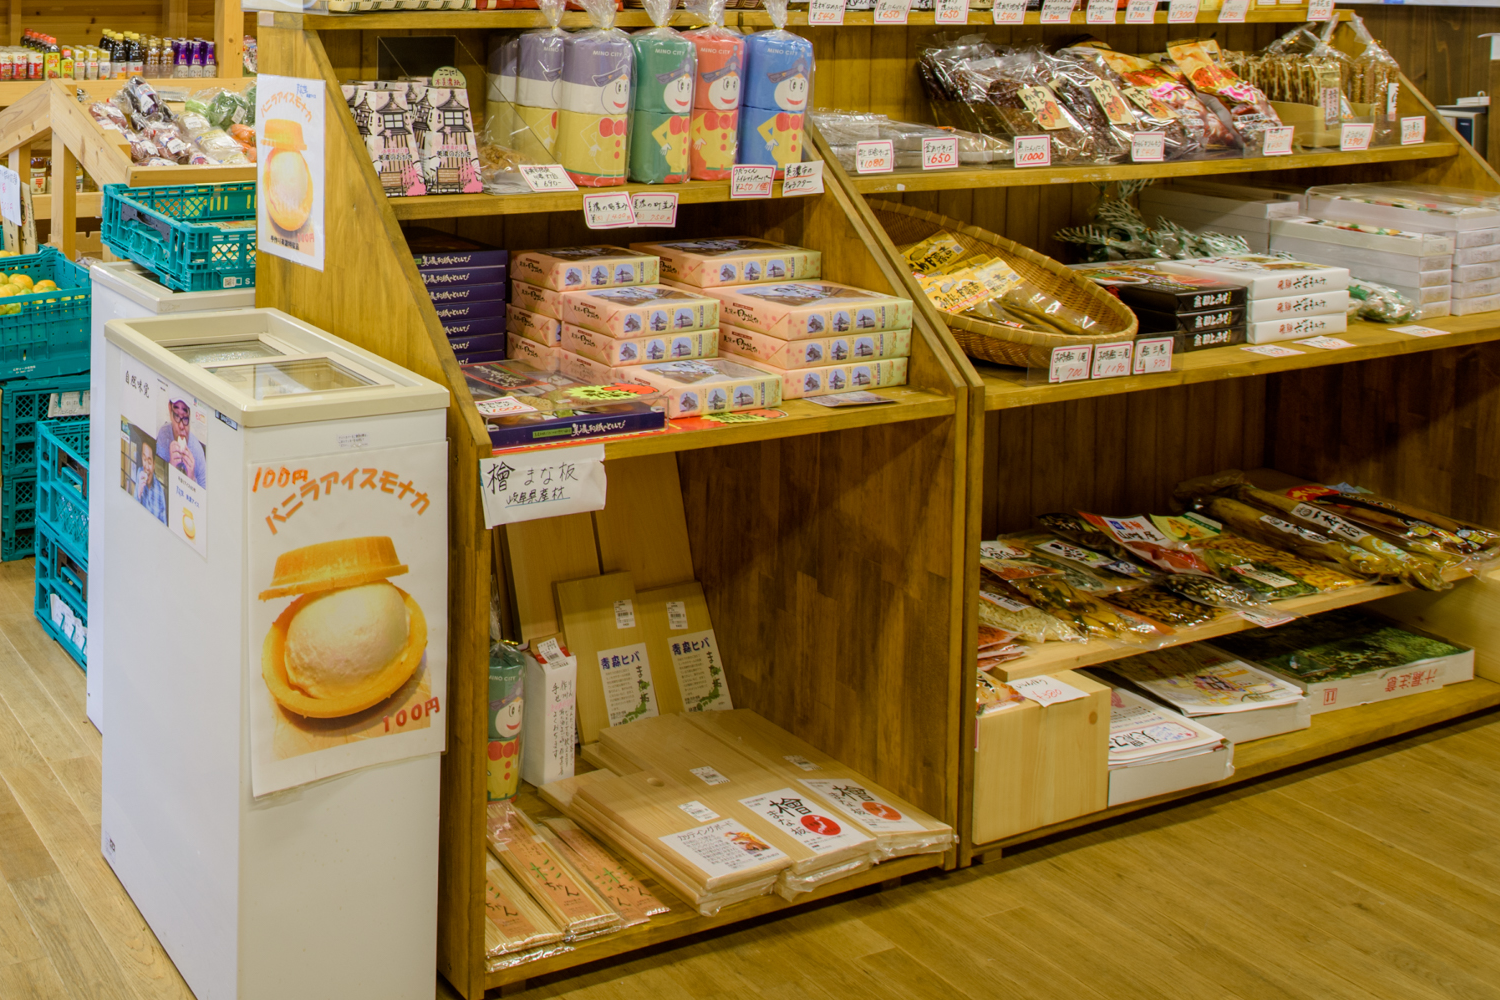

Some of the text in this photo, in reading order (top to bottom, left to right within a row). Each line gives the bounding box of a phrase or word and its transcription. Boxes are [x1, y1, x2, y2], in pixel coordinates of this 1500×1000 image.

[260, 91, 313, 123] バニラアイスモナカ
[927, 153, 951, 164] ¥650
[251, 464, 310, 494] 100円
[522, 460, 579, 488] まな板
[263, 466, 432, 536] バニラアイスモナカ
[600, 650, 641, 671] 青森ヒバ
[671, 637, 712, 657] 青森ヒバ
[380, 695, 442, 735] 100円
